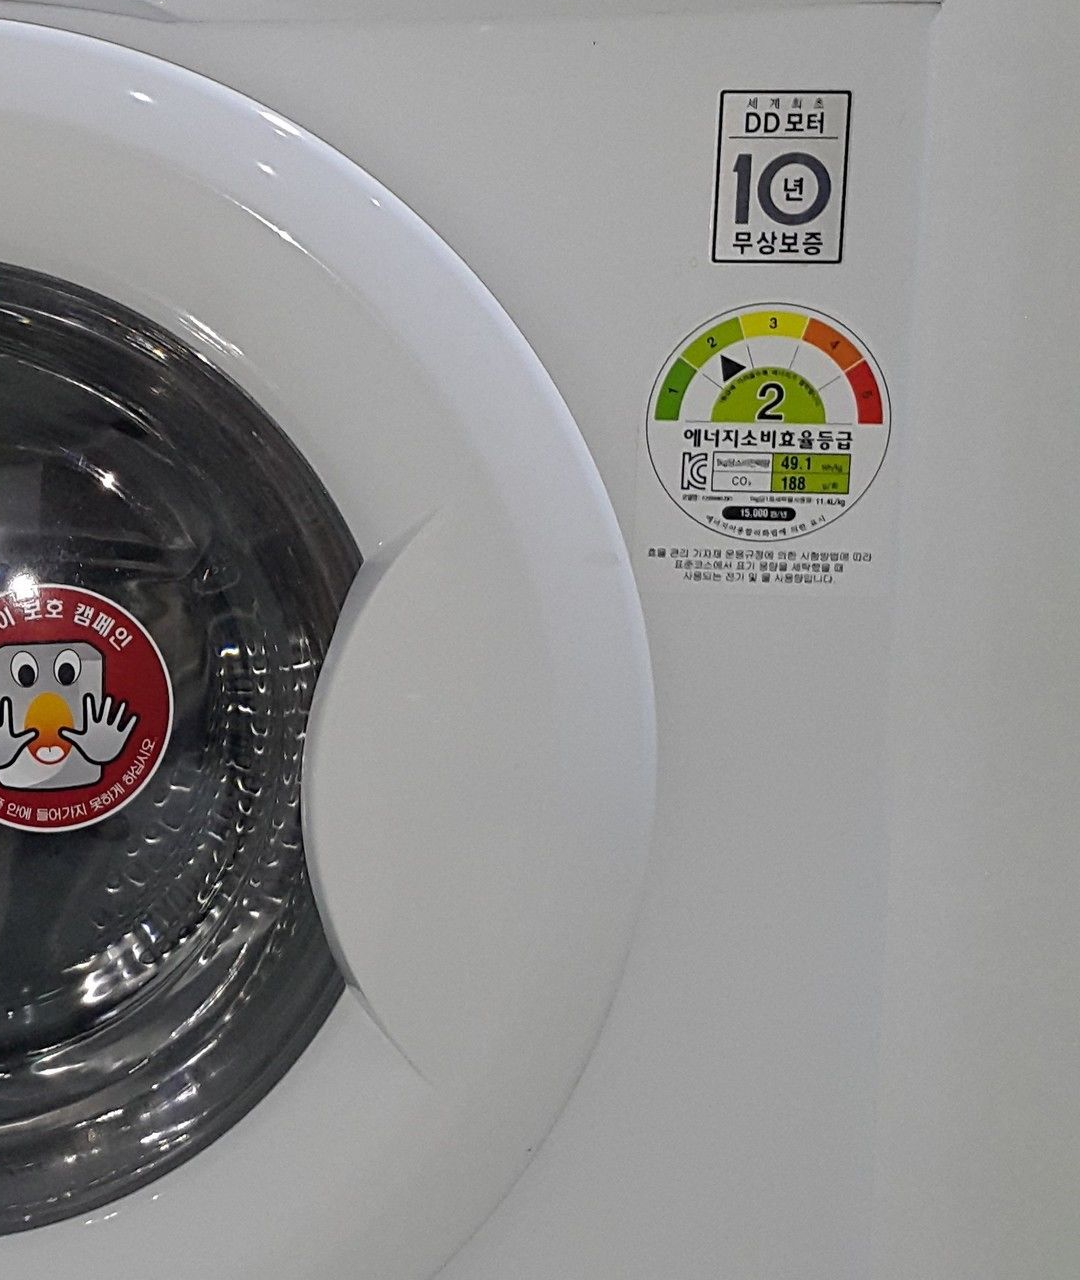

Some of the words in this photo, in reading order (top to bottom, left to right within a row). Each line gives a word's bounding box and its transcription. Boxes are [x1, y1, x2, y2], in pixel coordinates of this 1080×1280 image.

[733, 231, 823, 255] 무상보증
[769, 317, 778, 329] 3
[706, 336, 718, 348] 2
[829, 340, 840, 350] 4
[756, 382, 784, 421] 2
[684, 429, 853, 451] 에너지소비효율등급
[781, 456, 812, 471] 49.1
[781, 476, 806, 490] 188
[853, 552, 872, 562] 따라
[22, 599, 64, 620] 보호
[73, 602, 132, 651] 캠페인
[6, 802, 32, 820] 안에
[37, 803, 87, 821] 들어가지
[90, 782, 123, 810] 못하게
[122, 738, 155, 785] 하십시오
